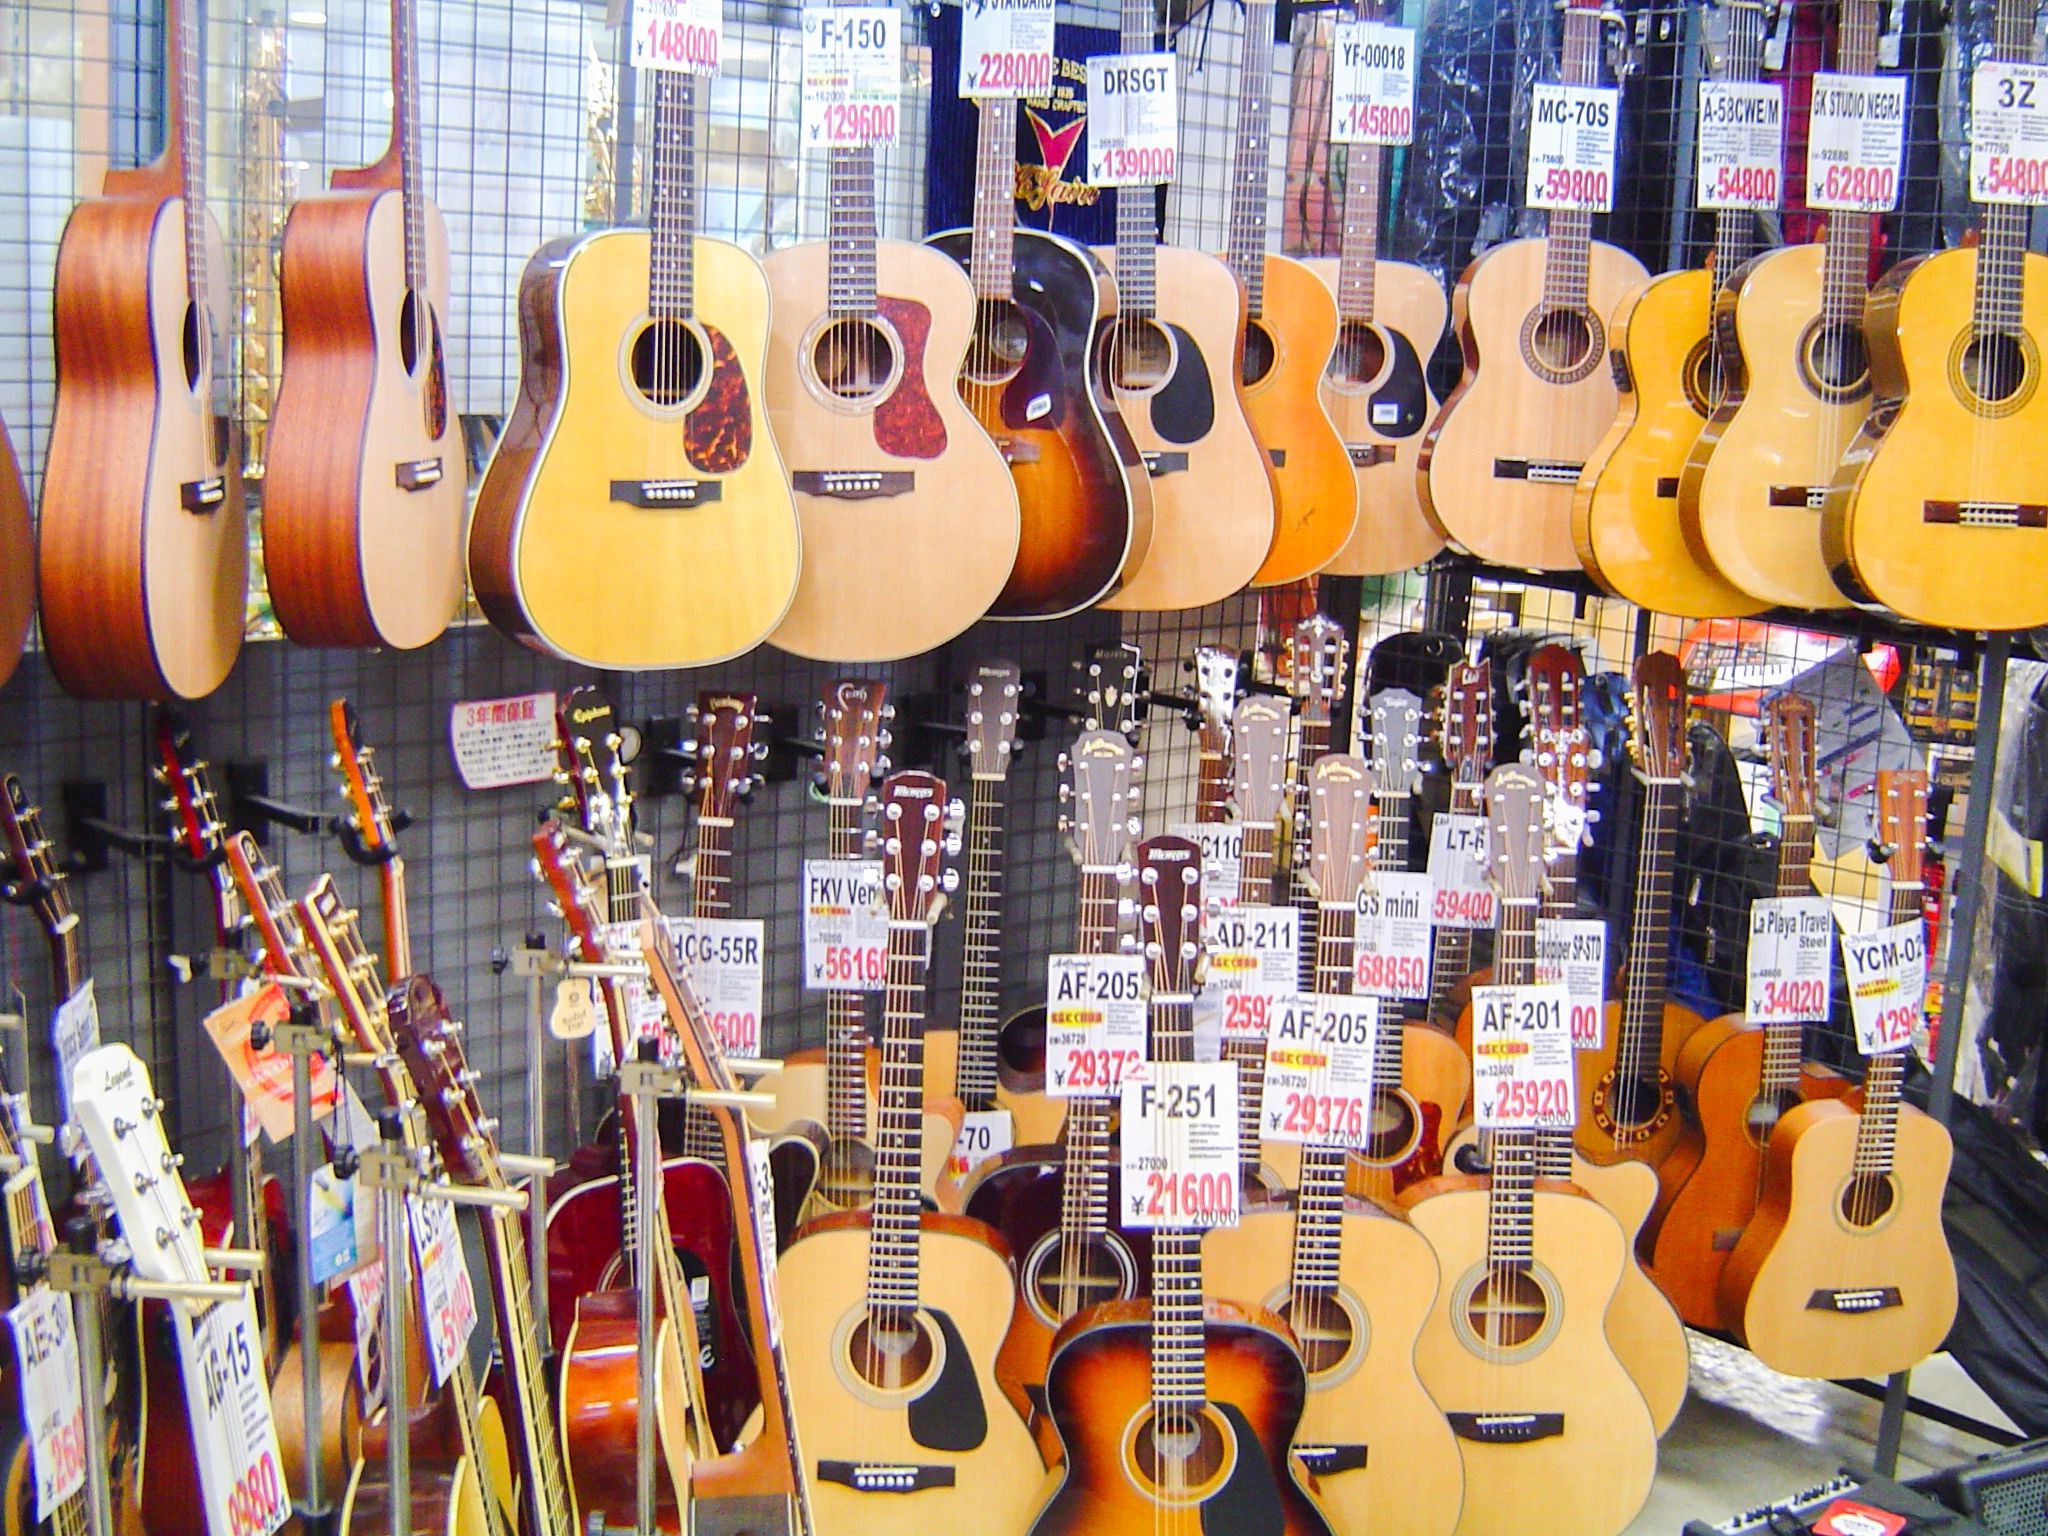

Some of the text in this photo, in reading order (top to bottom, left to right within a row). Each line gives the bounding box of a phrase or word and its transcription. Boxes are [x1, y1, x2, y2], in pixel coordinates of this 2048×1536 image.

[648, 19, 718, 65] 148000
[821, 19, 886, 49] F-150
[979, 52, 1051, 89] 228000
[1343, 43, 1405, 71] YF-00018
[1103, 67, 1169, 95] DRSGT
[1998, 79, 2036, 109] 3Z
[823, 103, 896, 141] 129600
[1348, 104, 1411, 138] 145800
[1538, 98, 1609, 127] MC-70S
[1867, 92, 1902, 120] NEGRA
[1102, 147, 1175, 178] 139000
[1545, 168, 1608, 204] 59800
[1717, 166, 1777, 201] 54800
[1825, 164, 1894, 202] 62800
[811, 878, 842, 905] FKV
[1385, 891, 1419, 918] mini
[1434, 888, 1493, 922] 59400
[1217, 922, 1290, 948] AD-211
[1768, 911, 1796, 939] Playa
[1800, 911, 1830, 933] Travel
[1799, 936, 1827, 948] Steel
[1057, 971, 1139, 1000] AF-205
[1358, 954, 1424, 990] 68850
[1764, 980, 1825, 1014] 34020
[1278, 1008, 1367, 1044] AF-205
[1482, 1000, 1560, 1032] AF-201
[1141, 1084, 1216, 1118] F-251
[1284, 1092, 1362, 1137] 29376
[1496, 1079, 1568, 1119] 25920
[1138, 1156, 1168, 1171] 27000
[1146, 1172, 1233, 1217] 21600
[1193, 1209, 1236, 1226] 20000
[203, 1320, 252, 1420] AG-15
